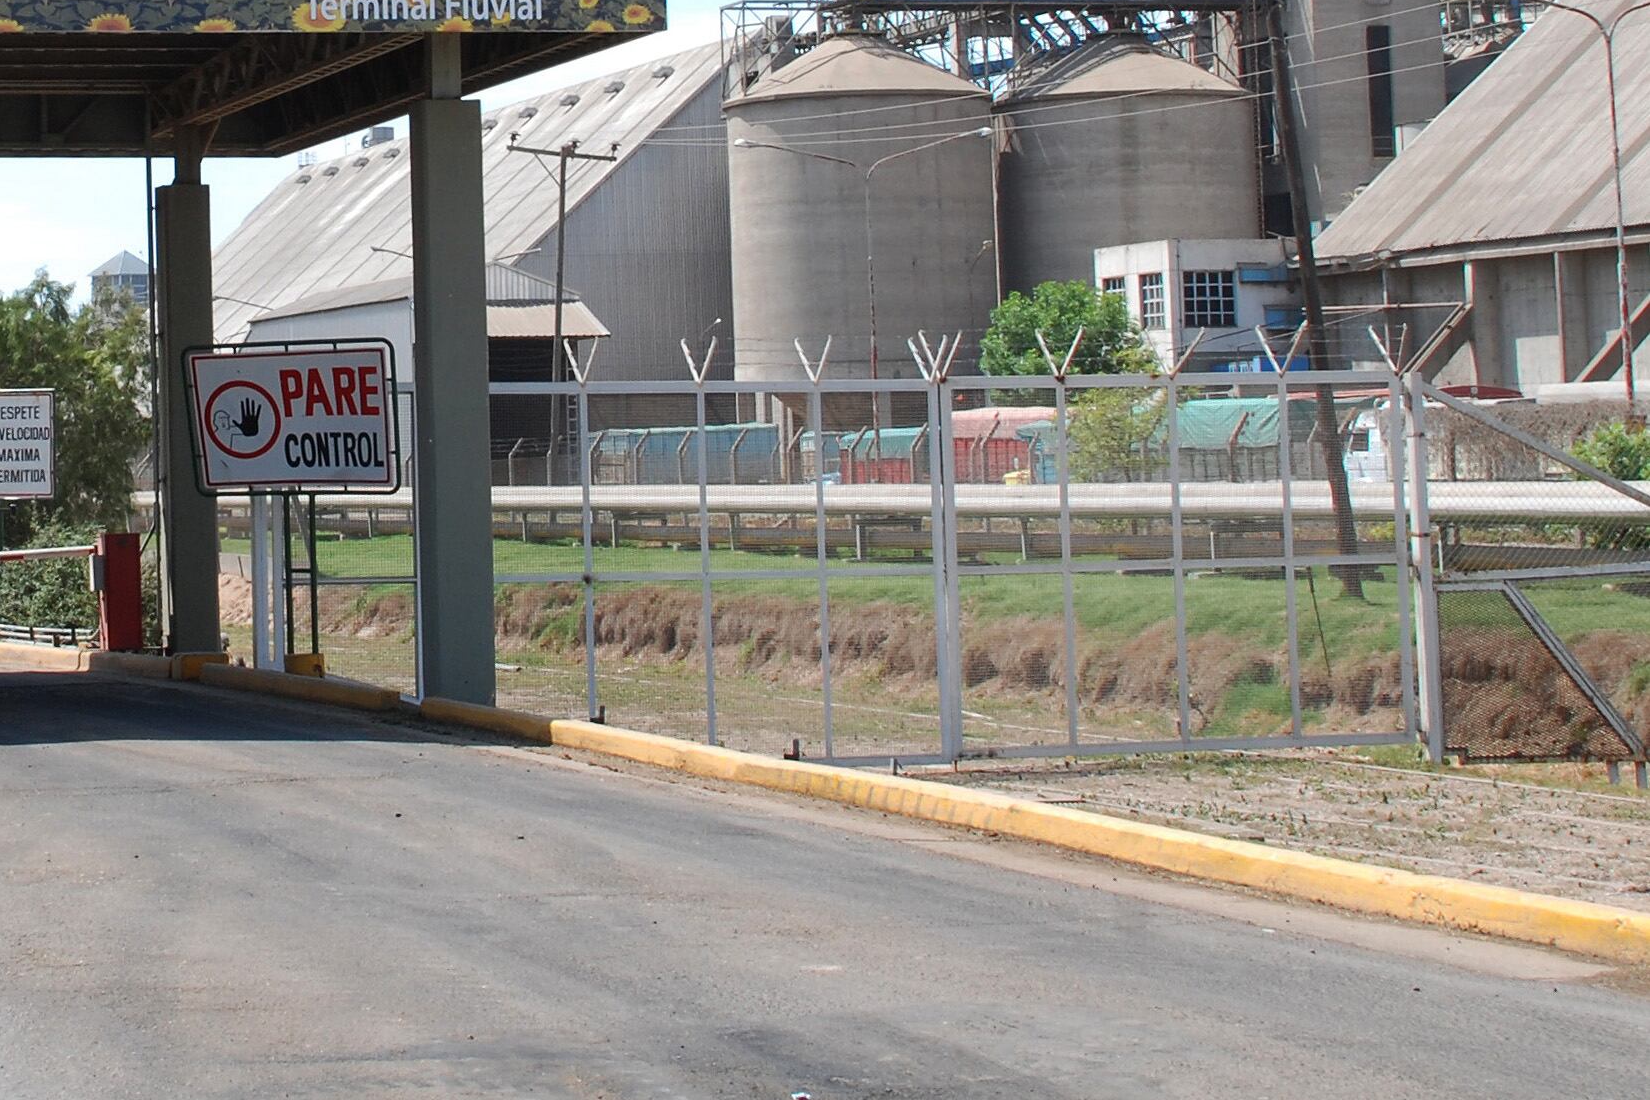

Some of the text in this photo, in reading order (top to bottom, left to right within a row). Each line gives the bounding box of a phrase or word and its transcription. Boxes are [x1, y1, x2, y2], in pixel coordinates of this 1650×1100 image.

[279, 366, 380, 418] PARE
[0, 427, 50, 441] VELOCIDAD
[284, 432, 384, 468] CONTROL
